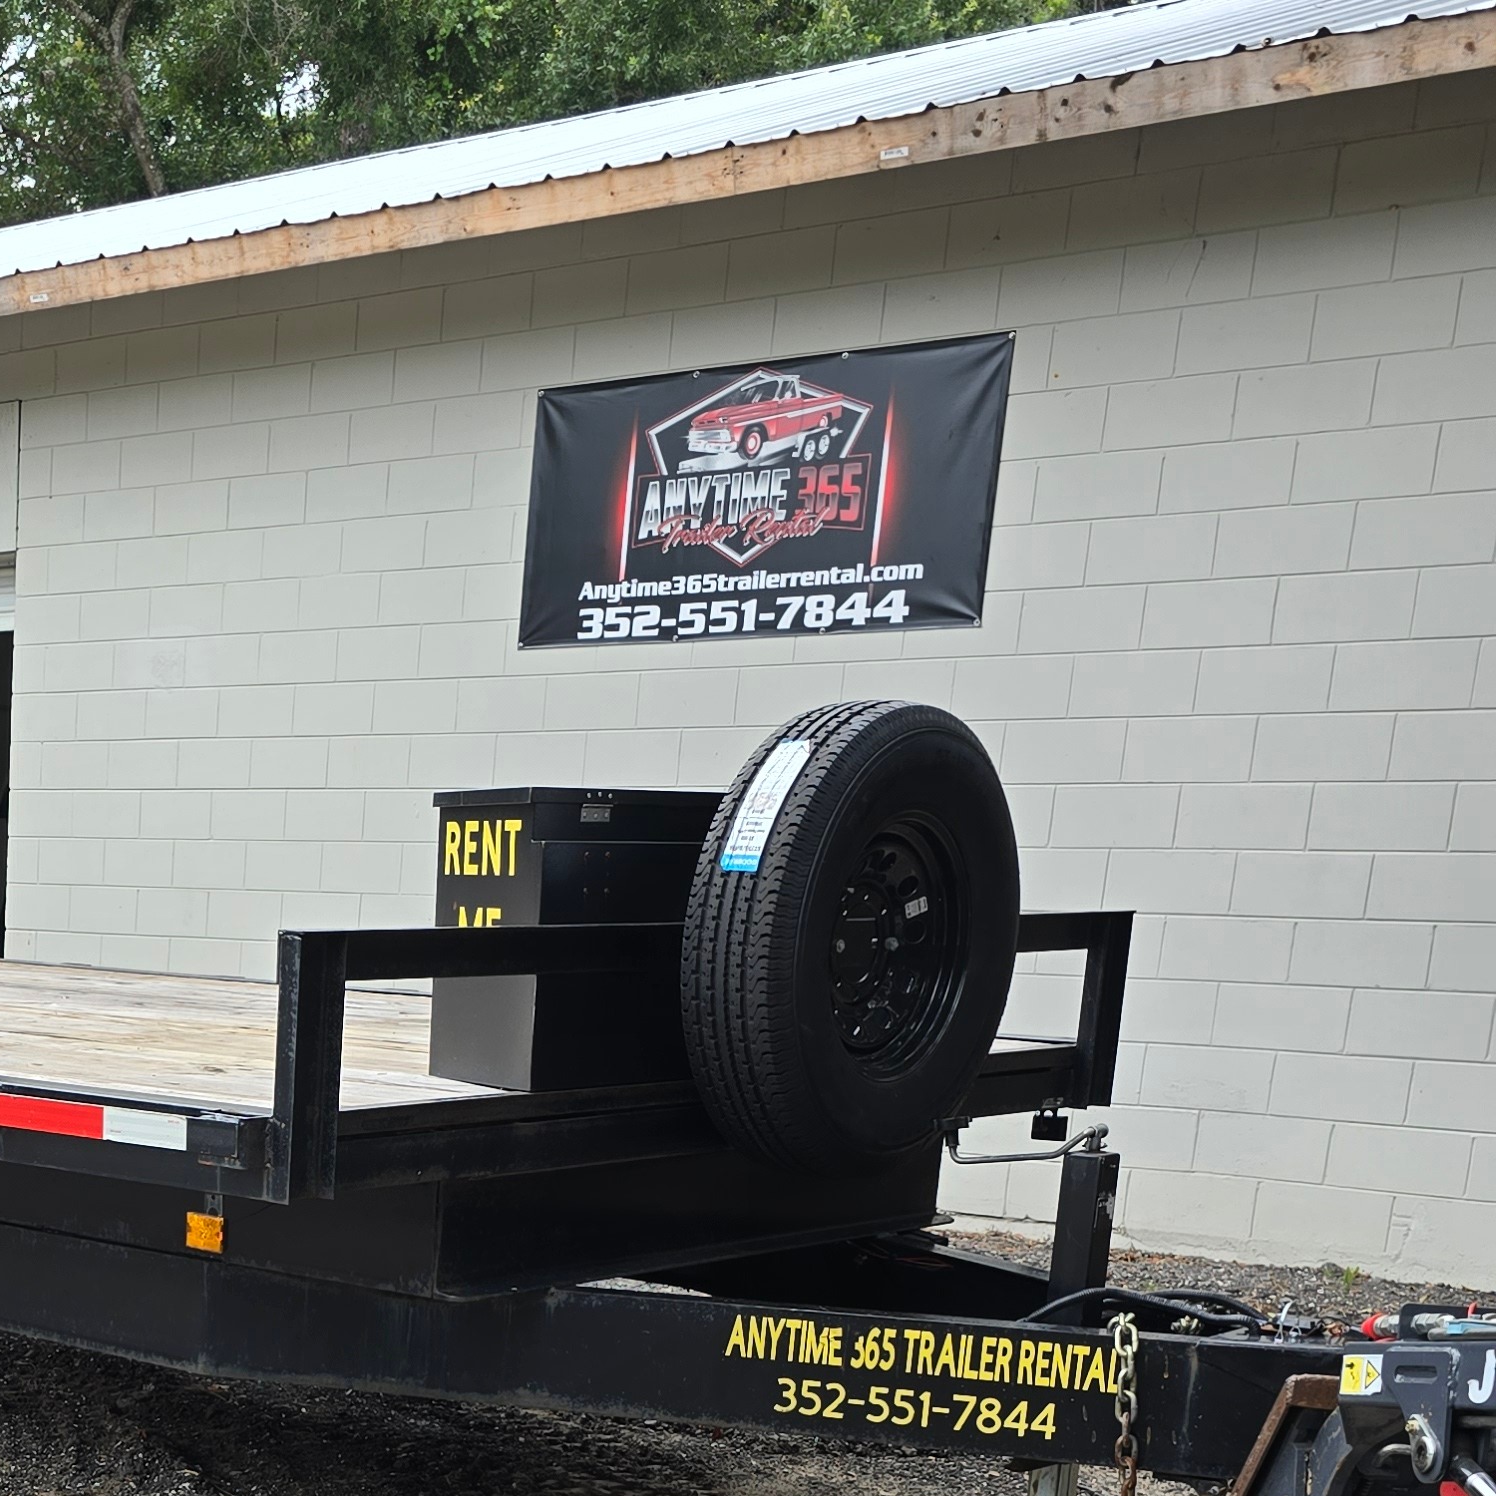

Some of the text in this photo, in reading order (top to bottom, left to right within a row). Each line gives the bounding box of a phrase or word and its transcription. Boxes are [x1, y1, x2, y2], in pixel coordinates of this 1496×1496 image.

[638, 462, 863, 540] ANYTIME 365
[657, 507, 831, 554] Trailer Rental
[577, 563, 925, 603] Anytime365trailerrental.com
[577, 589, 911, 640] 352-551-7844
[444, 819, 523, 877] RENT
[724, 1314, 843, 1367] ANYTIME
[903, 1329, 1011, 1383] TRAILER
[1016, 1341, 1120, 1395] RENTAL
[773, 1377, 1057, 1441] 352-551-7844
